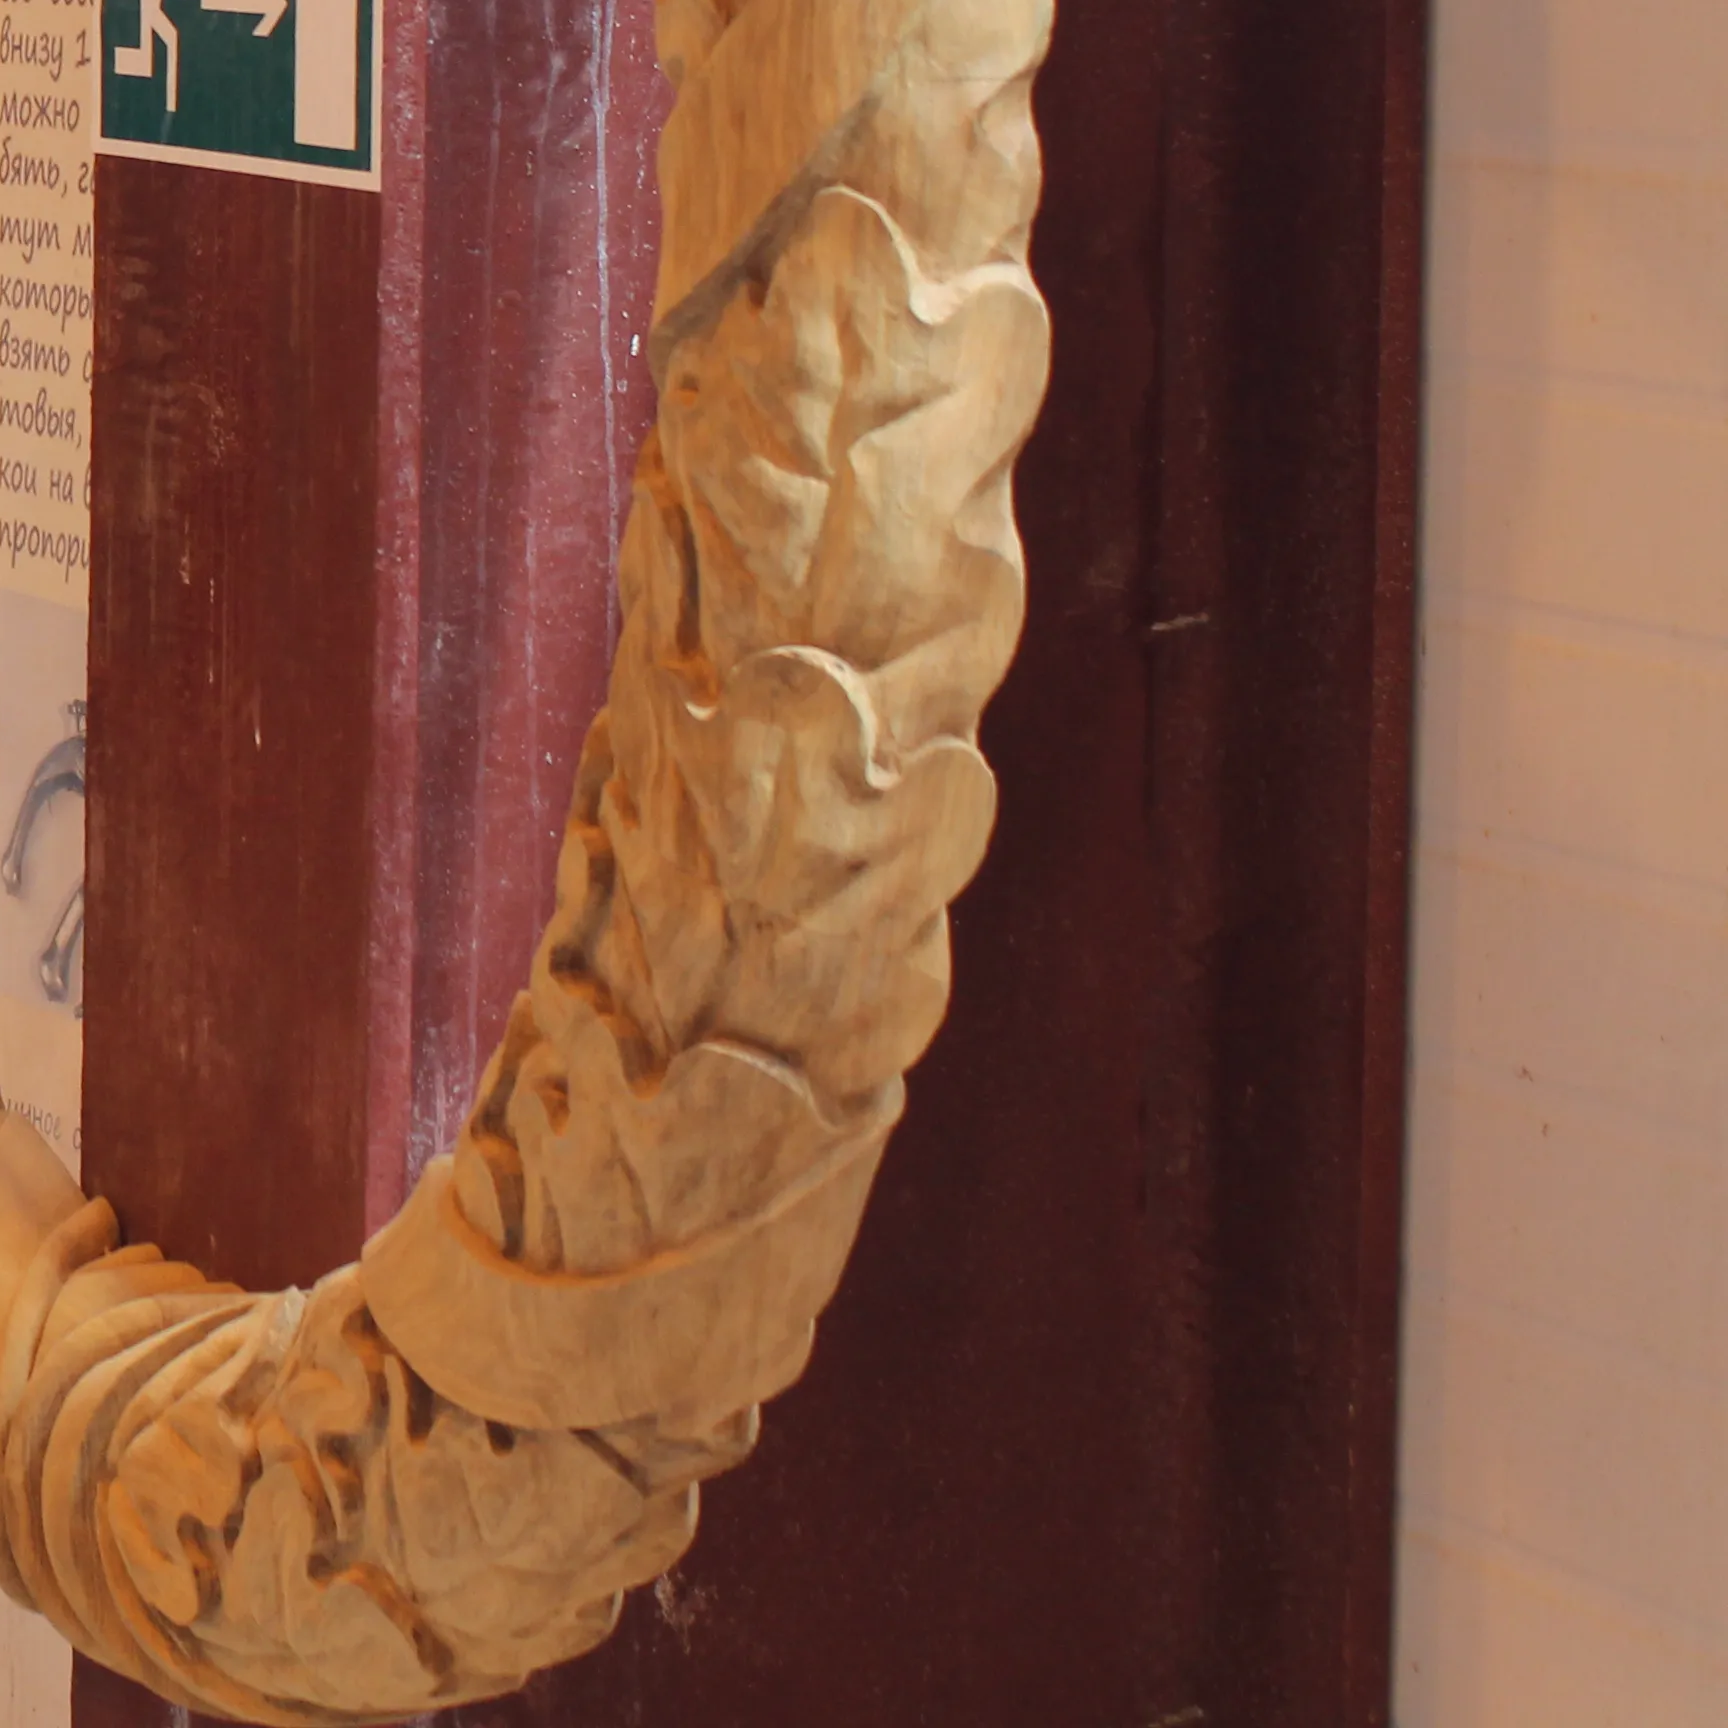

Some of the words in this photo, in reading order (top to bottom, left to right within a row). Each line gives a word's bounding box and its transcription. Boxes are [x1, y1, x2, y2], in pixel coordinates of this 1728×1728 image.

[0, 15, 64, 82] внизу
[0, 214, 61, 264] тут
[49, 468, 74, 505] на
